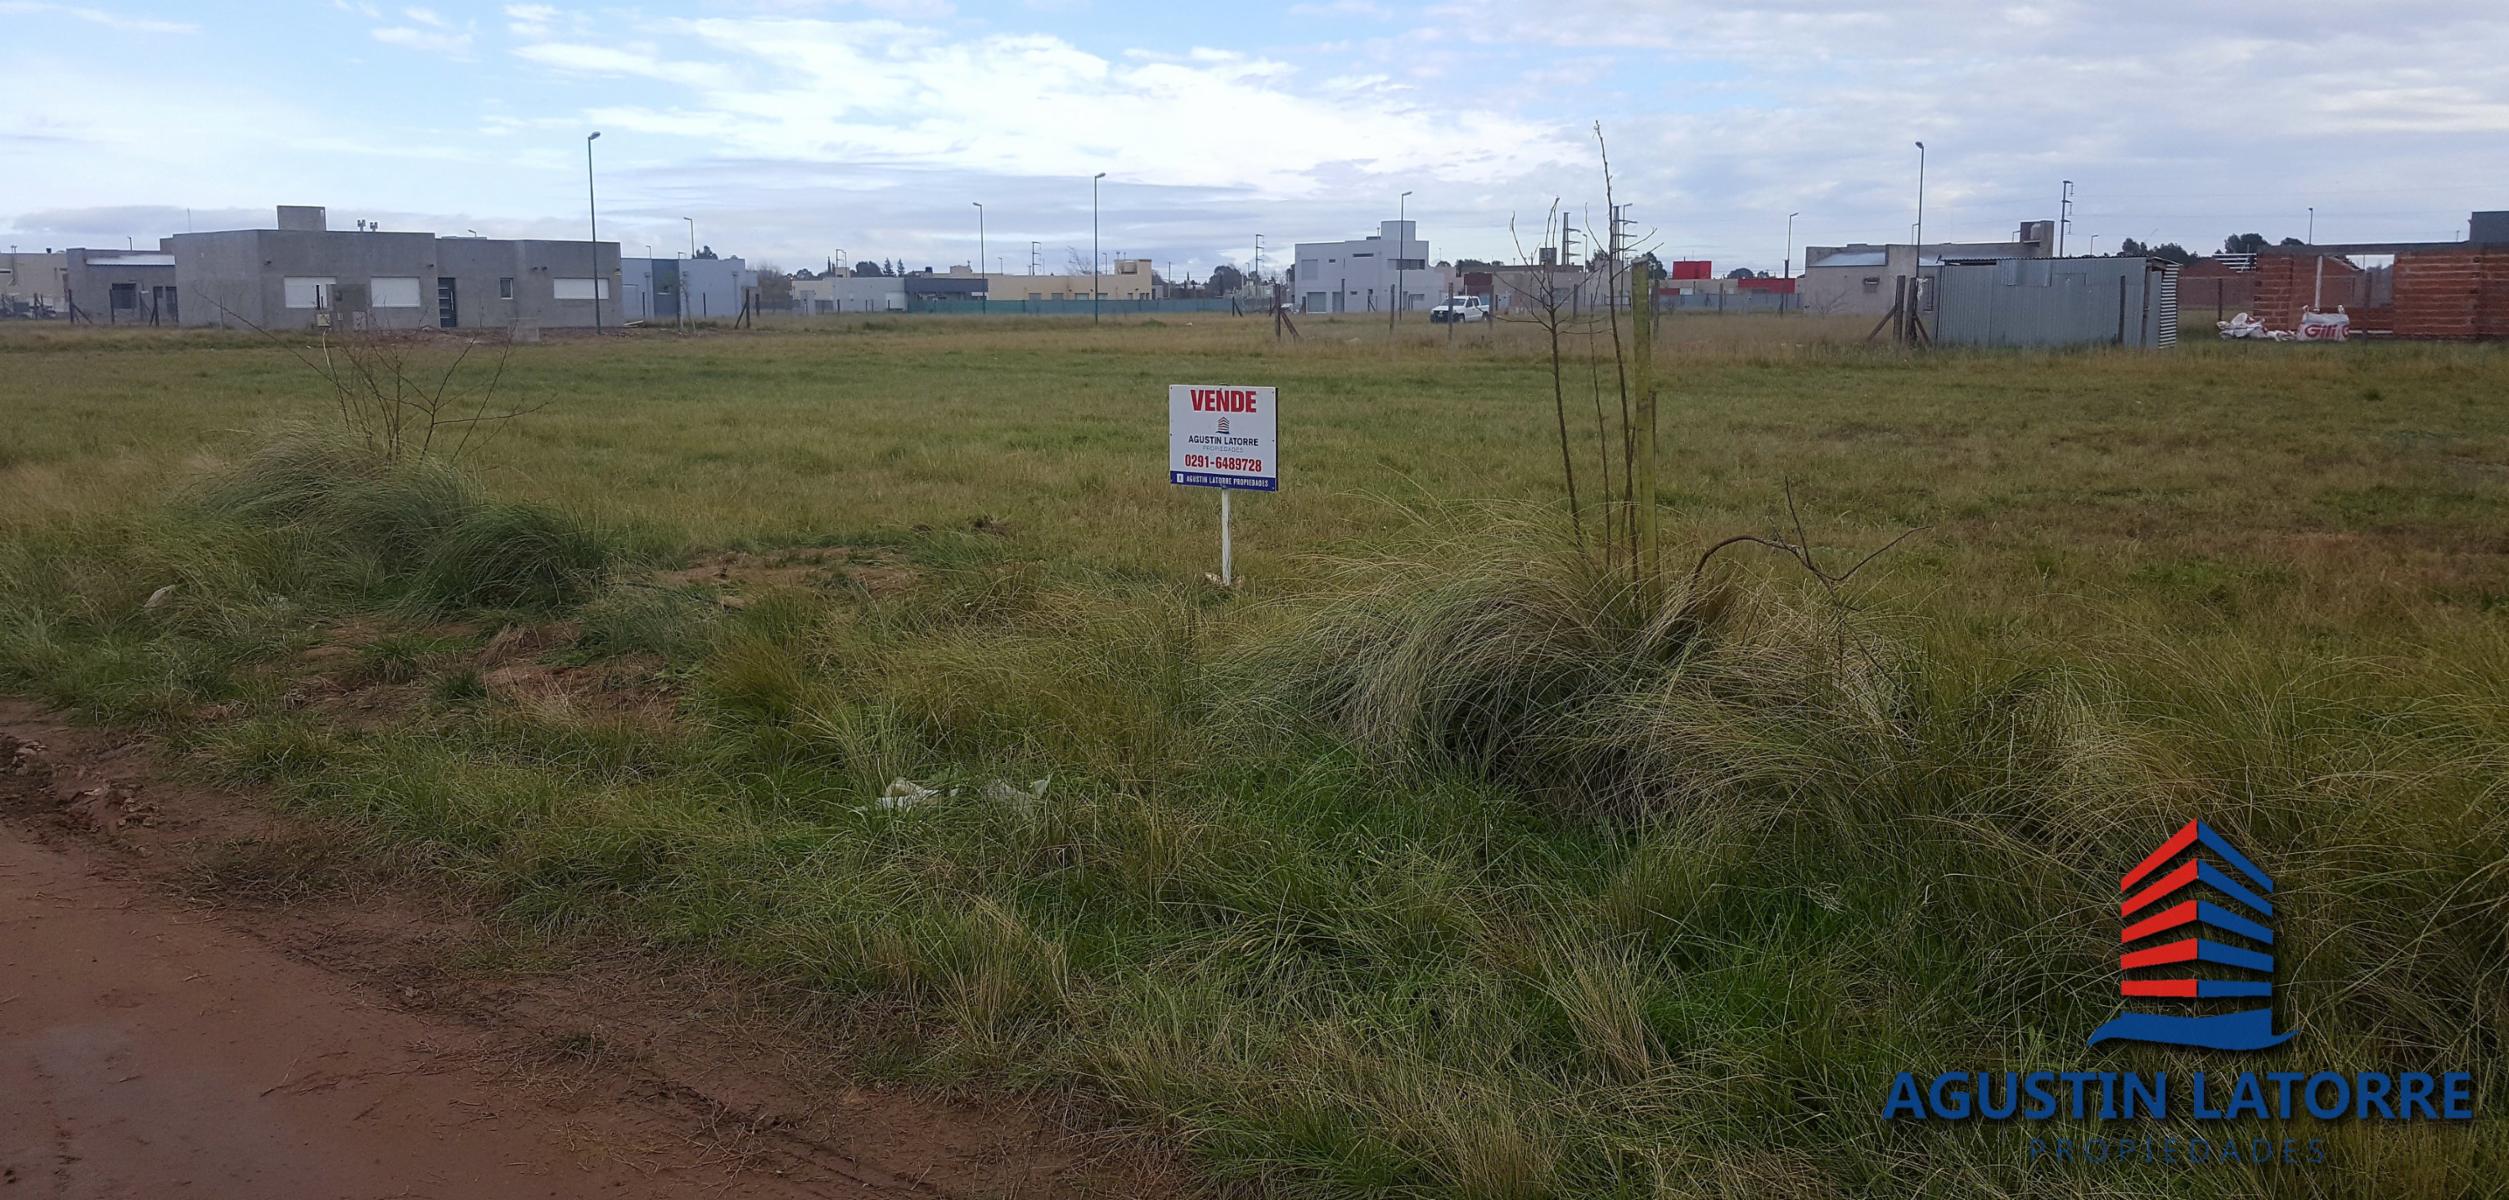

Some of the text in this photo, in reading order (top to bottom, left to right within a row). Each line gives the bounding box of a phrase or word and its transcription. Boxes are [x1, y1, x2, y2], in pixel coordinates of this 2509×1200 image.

[1190, 389, 1257, 413] VENDE
[1188, 435, 1258, 446] AGUSTIN LATORRE
[1184, 454, 1262, 472] 0291-6489728
[1186, 475, 1269, 487] AGUSTIN LATORRE PROPIEDADES
